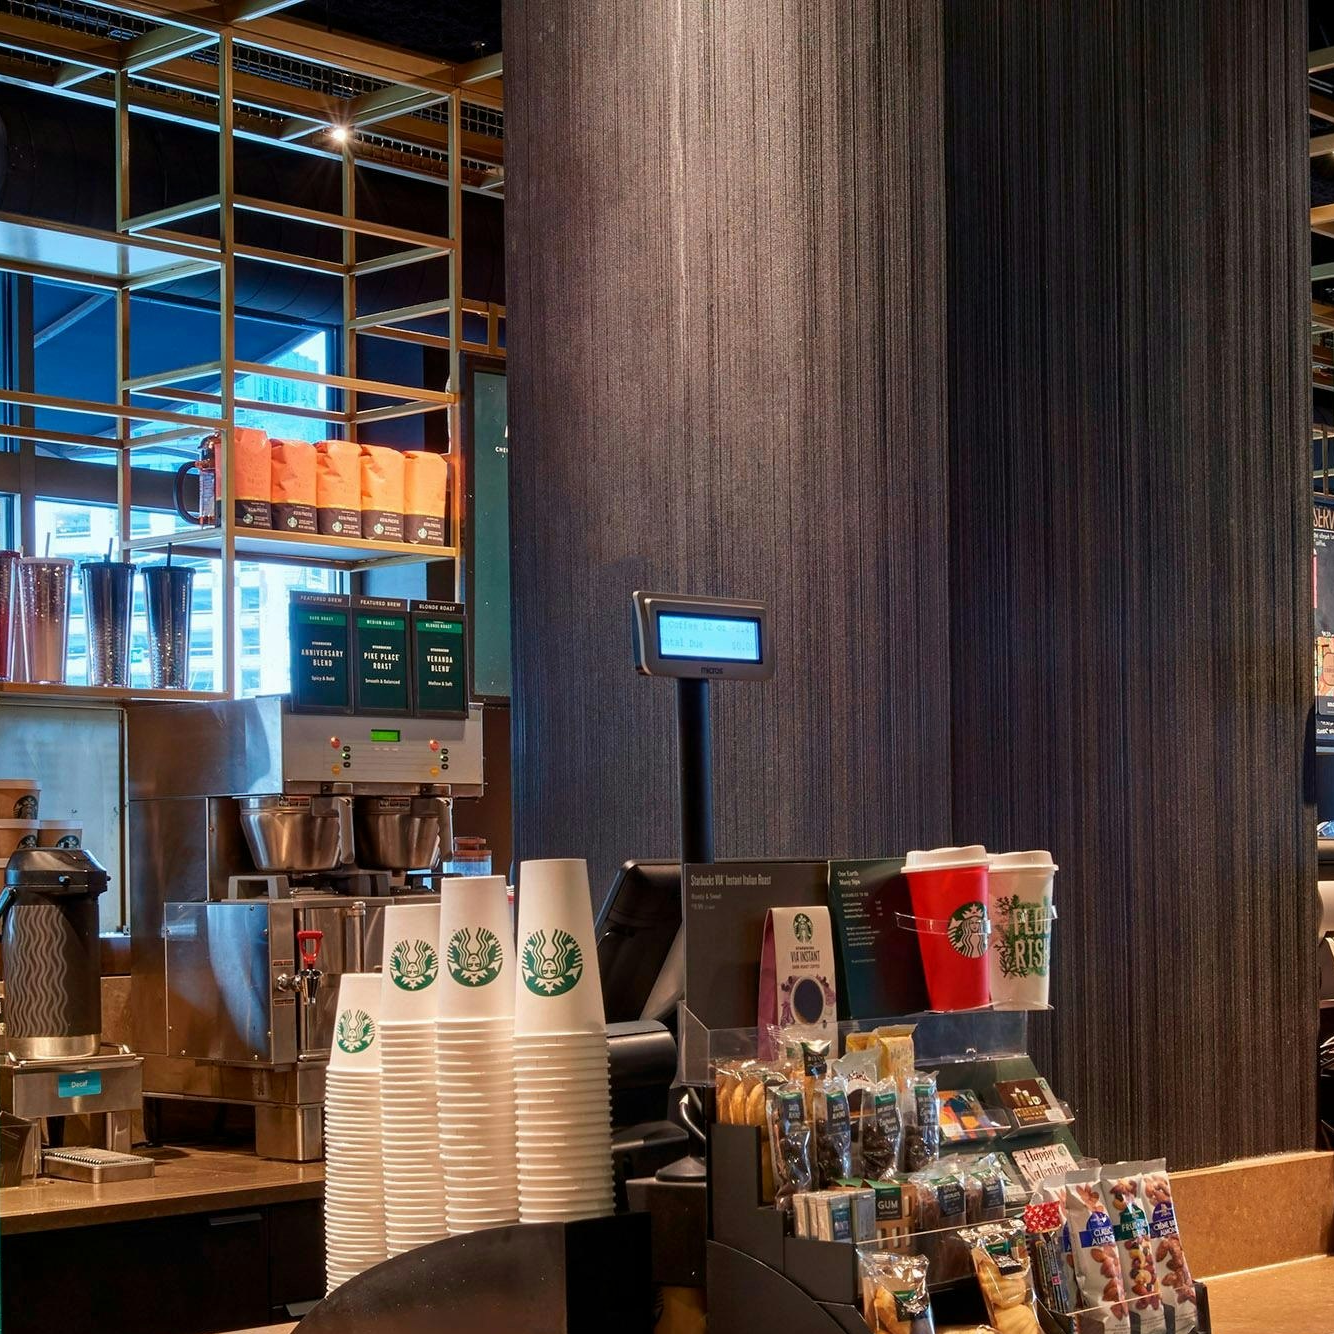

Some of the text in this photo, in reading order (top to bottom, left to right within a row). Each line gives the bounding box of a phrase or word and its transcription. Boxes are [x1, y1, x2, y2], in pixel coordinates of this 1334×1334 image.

[363, 652, 378, 661] PIKE
[426, 655, 453, 664] VERANDA
[312, 658, 333, 667] BLEND
[372, 662, 392, 671] ROAST
[71, 1080, 88, 1089] Decaf
[876, 1199, 899, 1211] GUM
